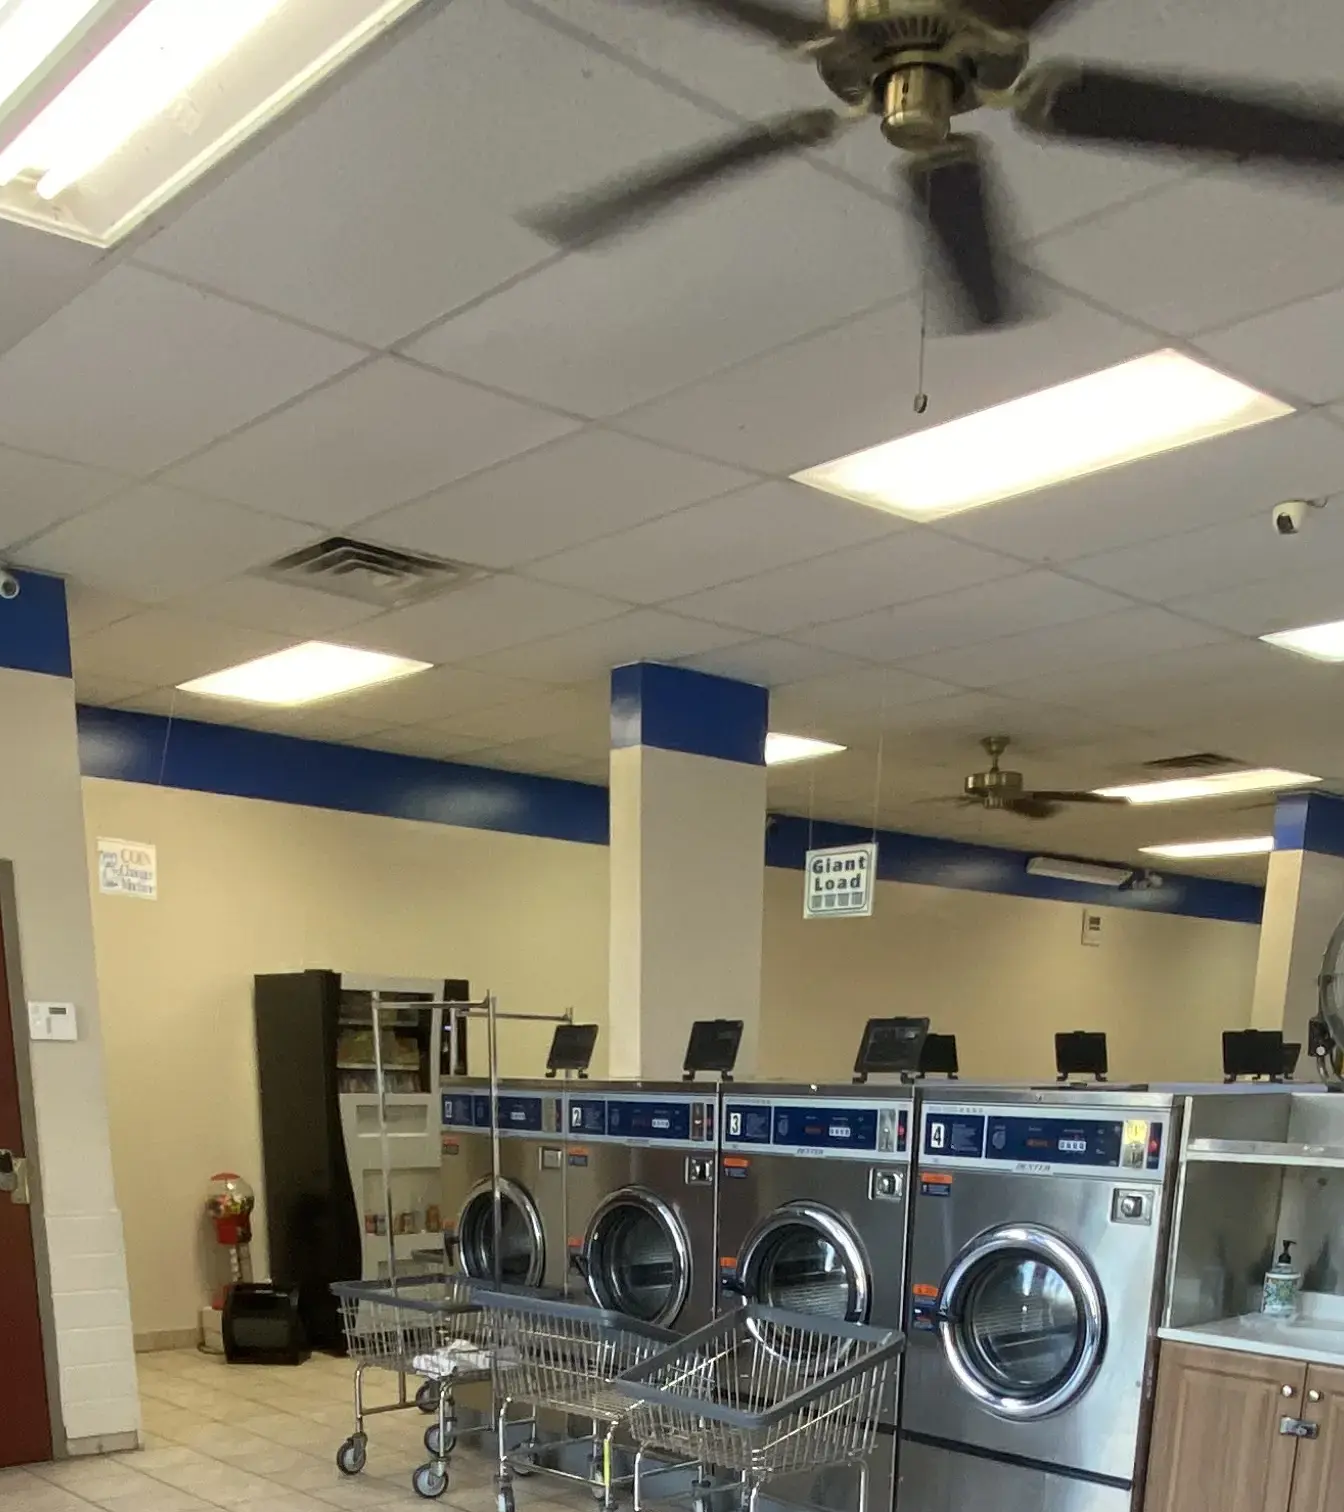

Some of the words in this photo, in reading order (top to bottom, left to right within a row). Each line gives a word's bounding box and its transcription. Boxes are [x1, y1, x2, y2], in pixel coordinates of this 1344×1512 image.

[812, 856, 866, 874] Giant
[814, 873, 861, 892] Load
[731, 1114, 740, 1134] 3
[932, 1125, 942, 1147] 4
